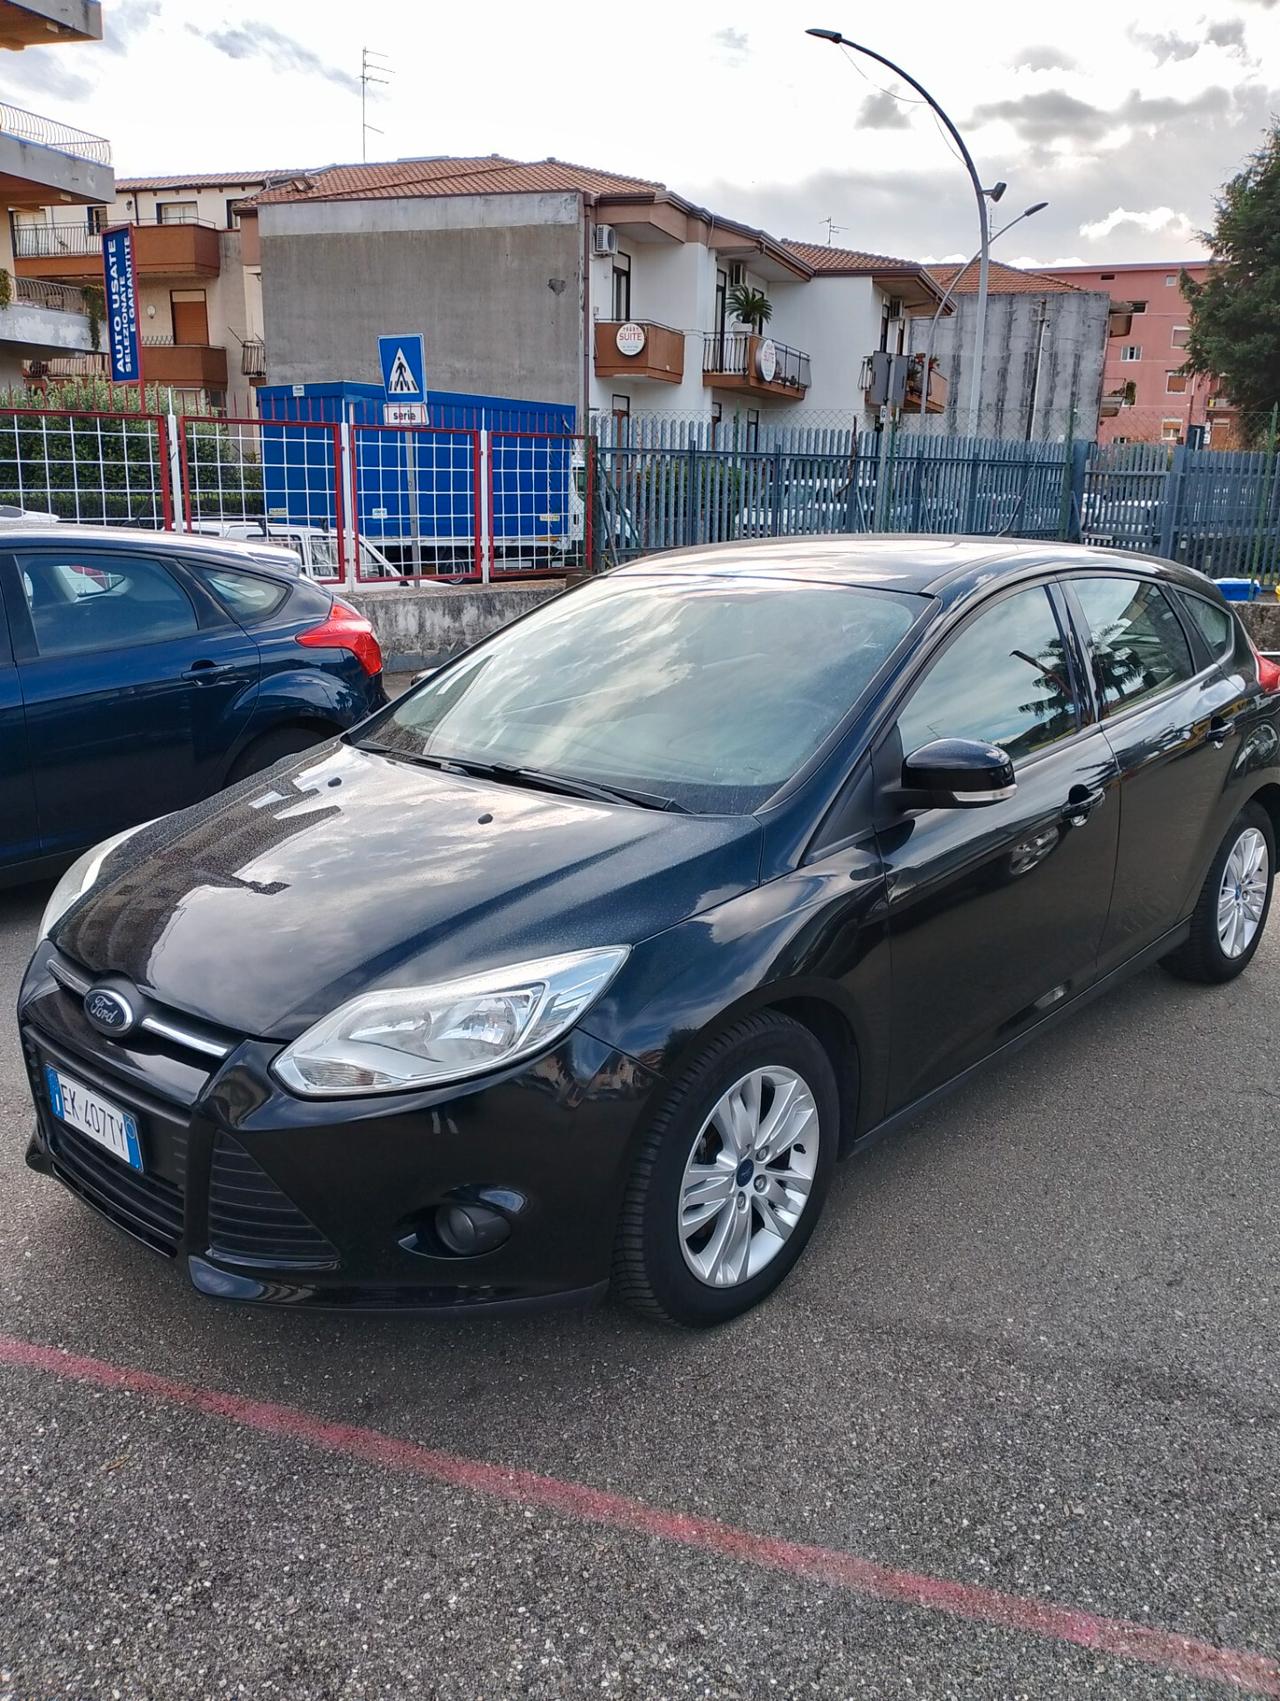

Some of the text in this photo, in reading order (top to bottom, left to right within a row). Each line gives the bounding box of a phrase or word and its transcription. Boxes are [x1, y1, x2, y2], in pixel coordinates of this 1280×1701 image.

[108, 239, 125, 373] AUTO USATE
[124, 235, 136, 332] E GARANTITE
[119, 276, 132, 373] SELEZIONATE
[619, 332, 643, 341] SUITE
[393, 410, 417, 421] serie
[90, 995, 119, 1024] Ford
[60, 1083, 125, 1152] EK 407TY
